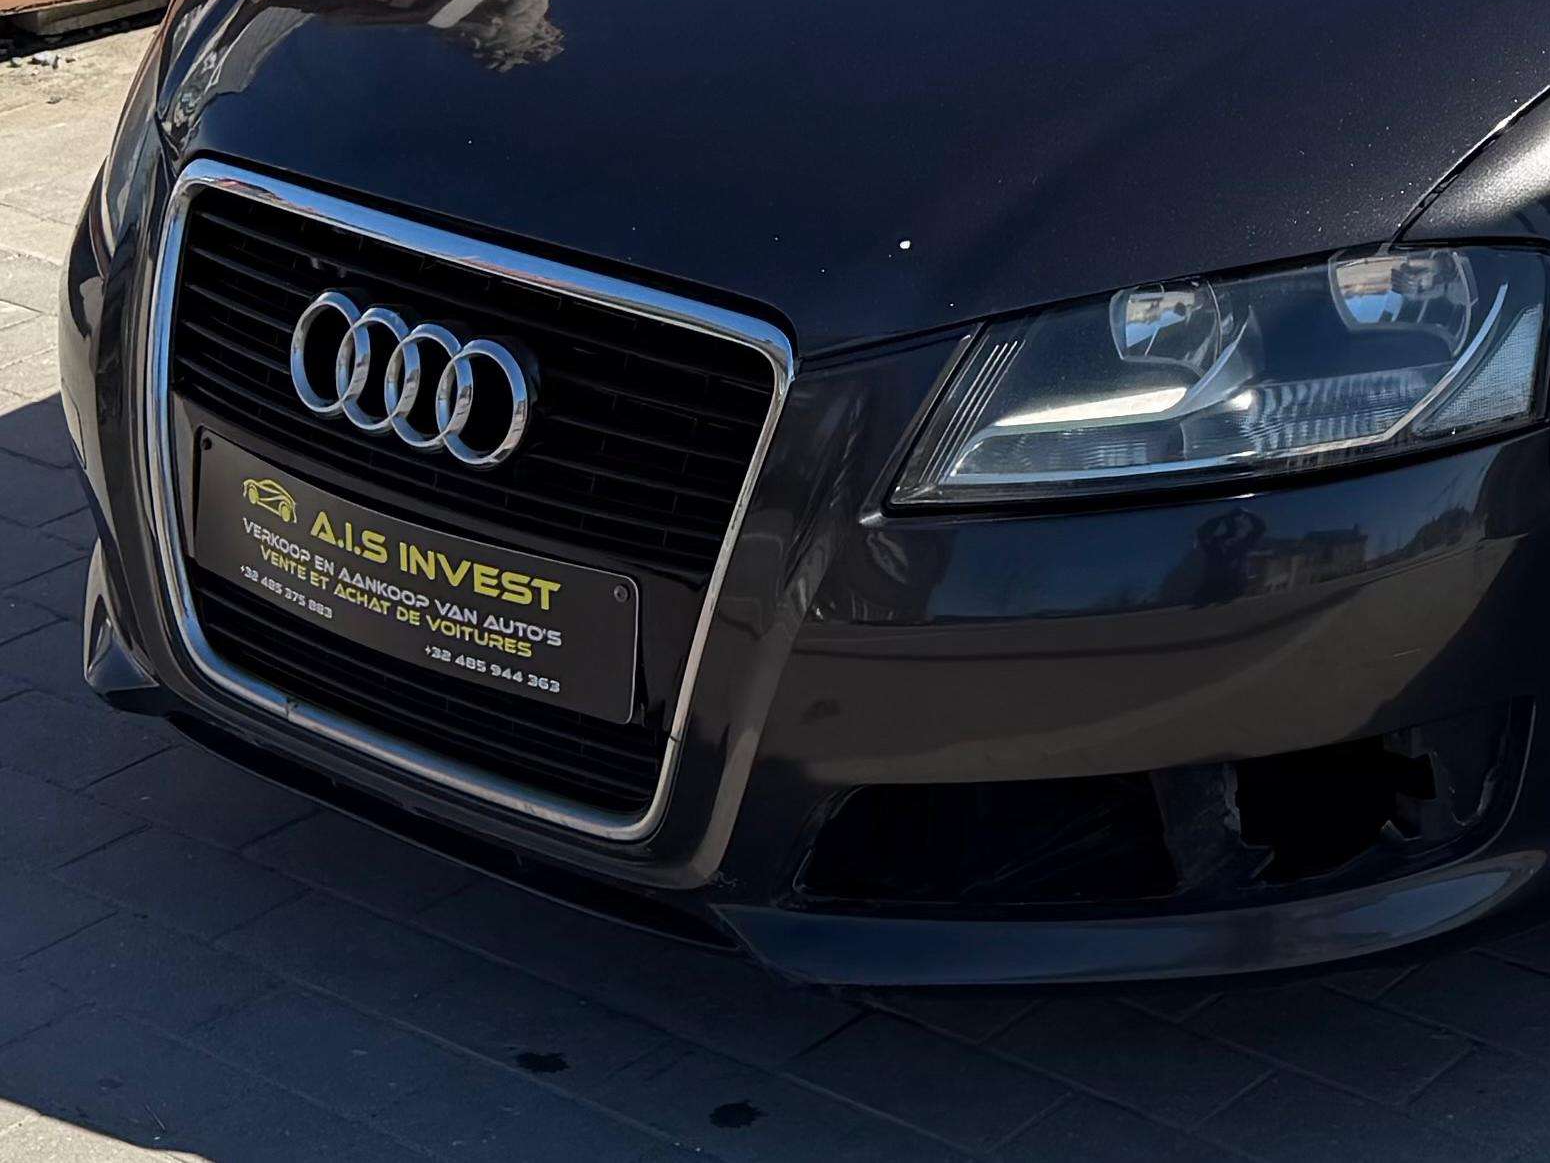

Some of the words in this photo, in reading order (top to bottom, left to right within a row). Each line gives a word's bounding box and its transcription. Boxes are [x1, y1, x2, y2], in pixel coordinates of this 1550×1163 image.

[243, 517, 311, 562] VERKOOP
[314, 554, 335, 577] EN
[338, 566, 430, 609] AANKOOP
[434, 598, 478, 626] VAN
[483, 614, 562, 647] AUTO'S
[260, 544, 307, 582] VENTE
[310, 570, 330, 590] ET
[334, 583, 392, 616] ACHAT
[396, 605, 421, 626] DE
[425, 614, 532, 658] VOITURES
[310, 510, 388, 564] A.I.S
[399, 541, 562, 611] INVEST
[425, 644, 451, 663] +32
[454, 653, 487, 674] 485
[490, 663, 524, 683] 944
[527, 673, 561, 694] 363
